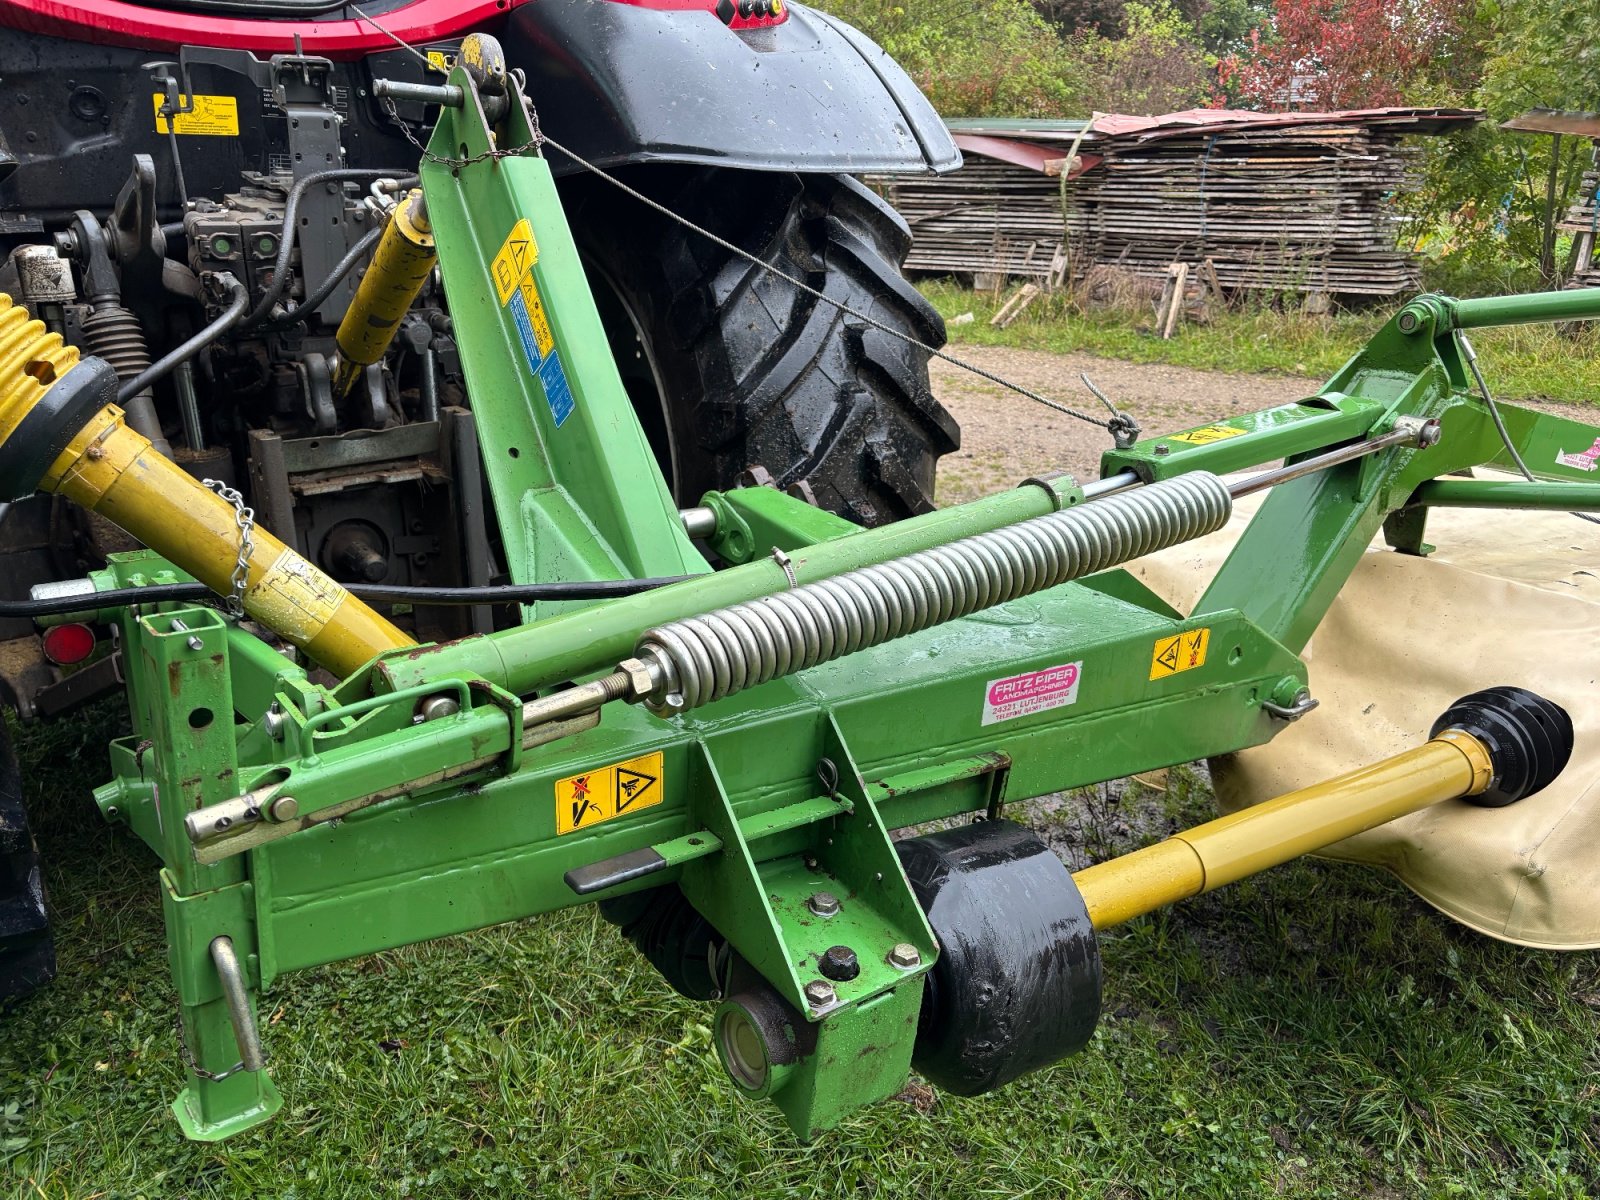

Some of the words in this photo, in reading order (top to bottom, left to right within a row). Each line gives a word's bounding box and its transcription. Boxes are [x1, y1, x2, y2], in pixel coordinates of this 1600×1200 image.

[995, 677, 1033, 695] FRITZ
[1035, 668, 1074, 685] PIPER
[997, 680, 1069, 703] LANDMASCHINEN
[992, 703, 1016, 715] 24321
